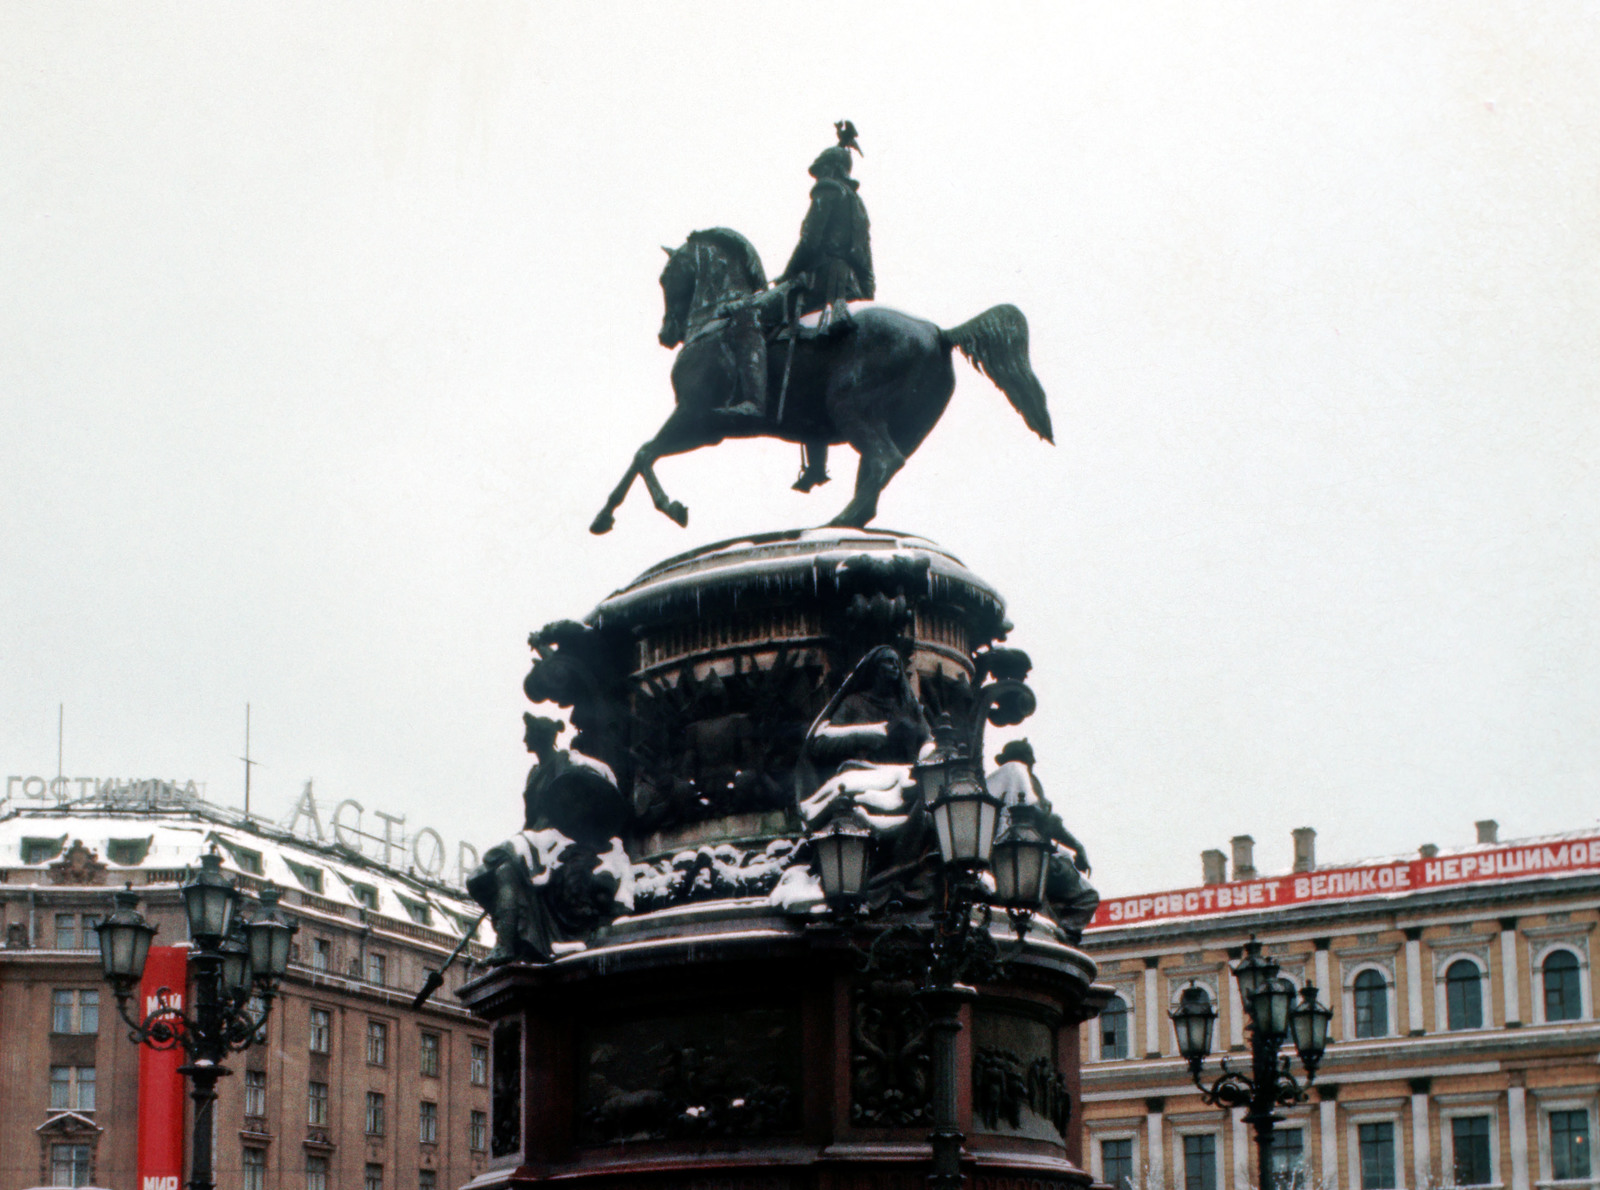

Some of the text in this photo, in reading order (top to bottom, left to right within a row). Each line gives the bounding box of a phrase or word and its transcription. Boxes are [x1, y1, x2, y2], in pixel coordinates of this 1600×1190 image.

[7, 775, 201, 803] ГОСТИНИЦА
[1109, 841, 1600, 921] ЗДРАВСТВУЕТ ВЕЛИКОЕ НЕРУШИМОЕ
